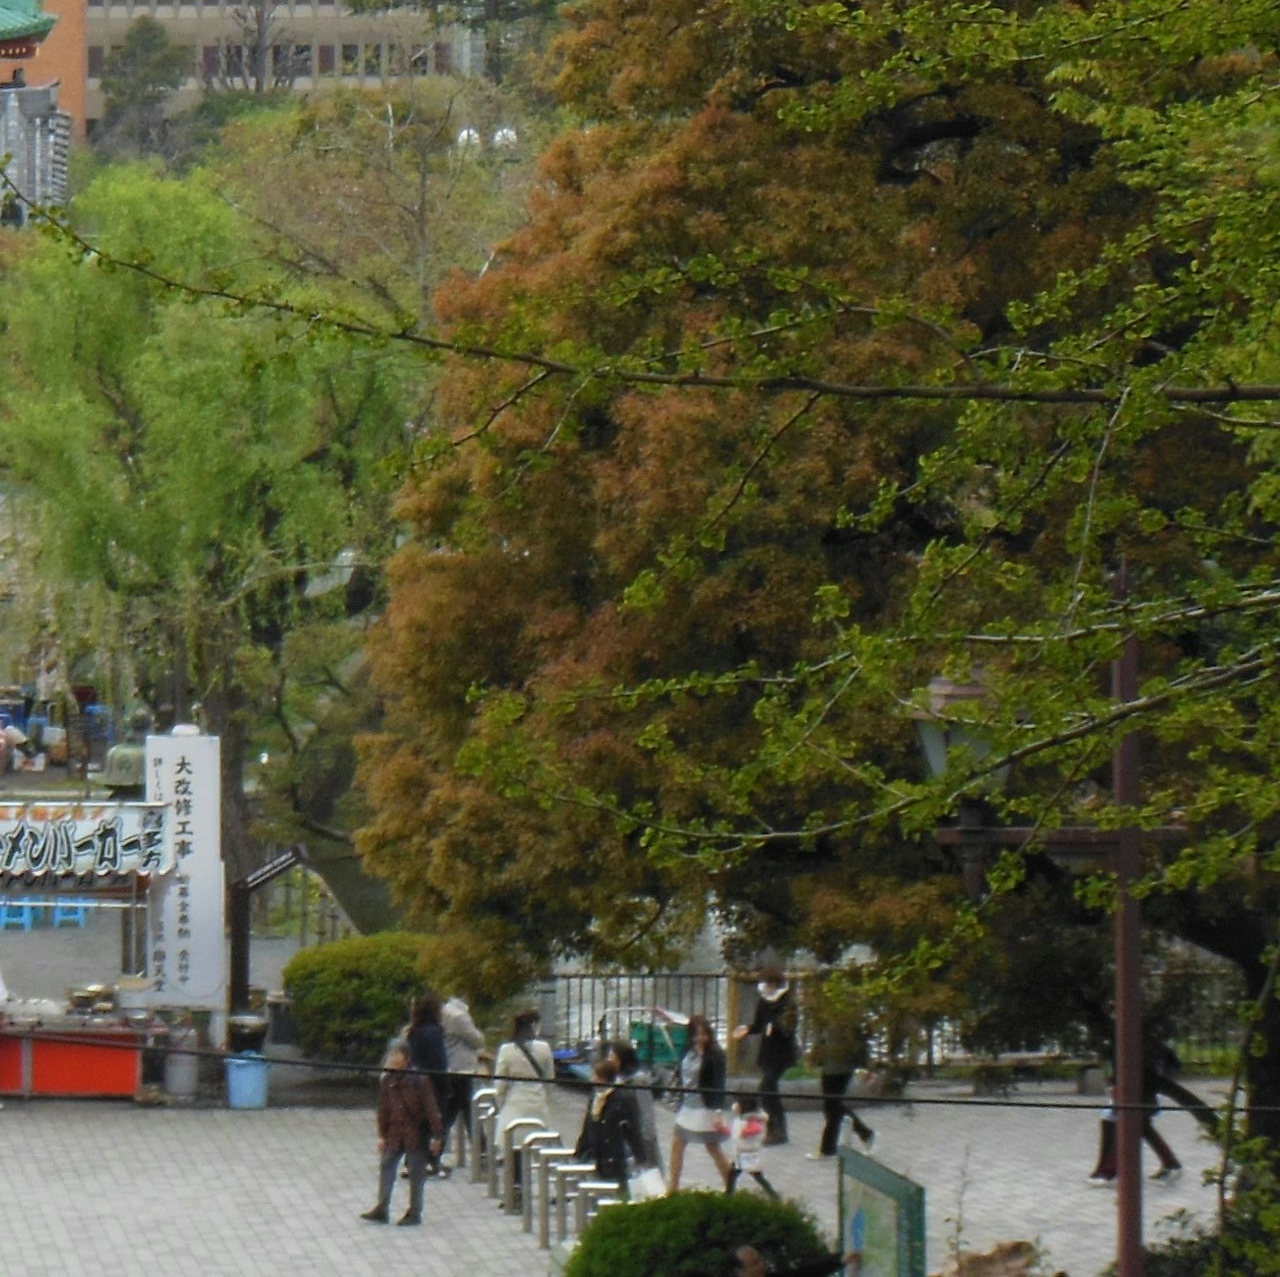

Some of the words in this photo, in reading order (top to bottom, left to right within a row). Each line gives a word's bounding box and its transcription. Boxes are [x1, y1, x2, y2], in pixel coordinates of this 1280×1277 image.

[174, 755, 193, 859] 大改修工事
